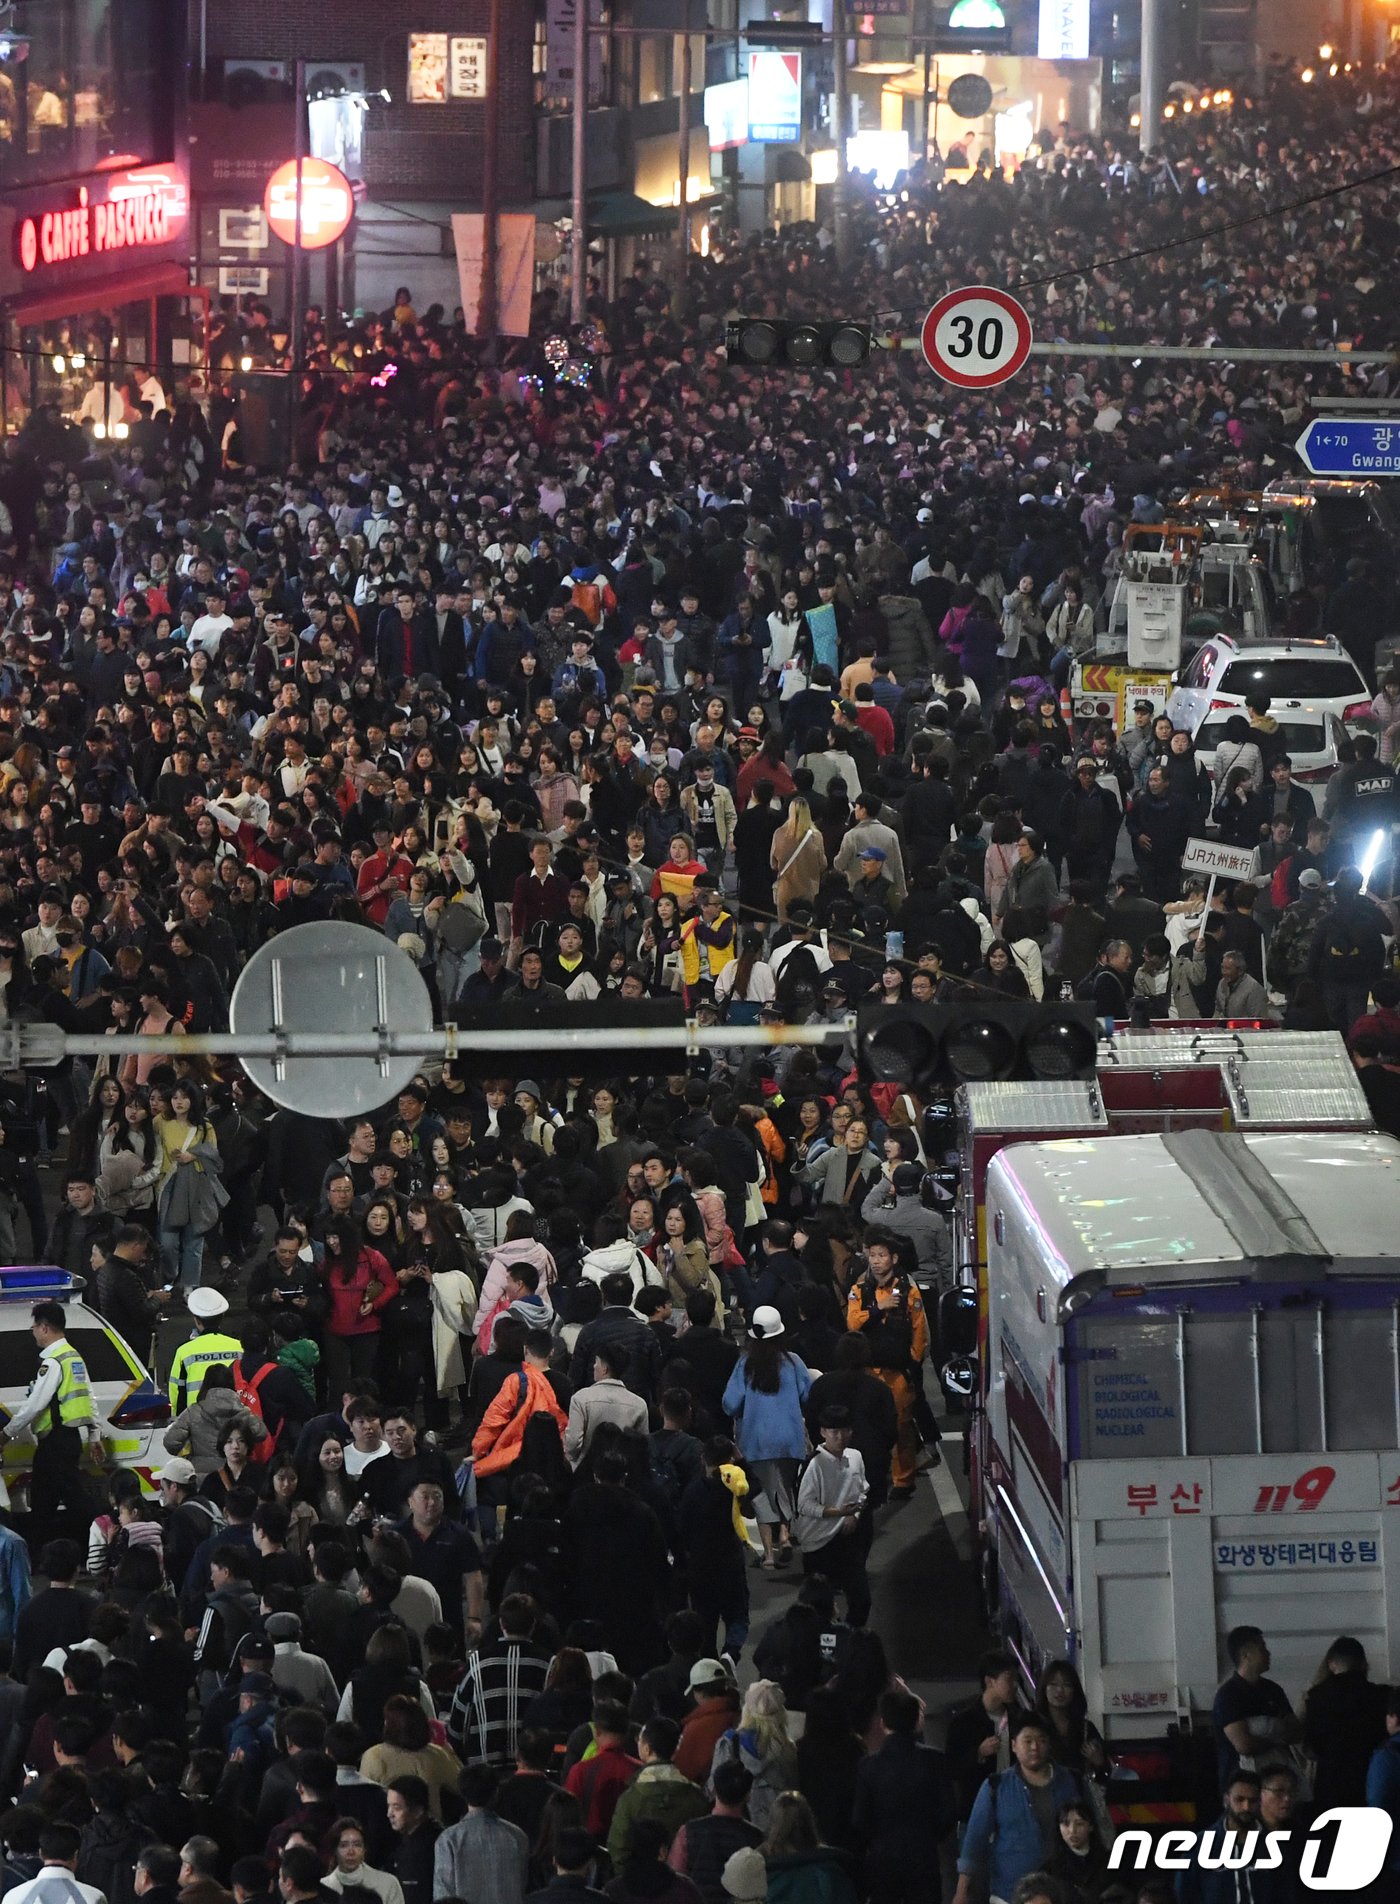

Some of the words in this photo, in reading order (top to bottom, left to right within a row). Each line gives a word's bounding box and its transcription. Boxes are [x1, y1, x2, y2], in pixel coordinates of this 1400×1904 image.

[95, 192, 168, 252] PASCUCCI
[948, 315, 1004, 360] 30
[1372, 427, 1400, 452] 광
[1187, 848, 1251, 872] JR九州旅行
[194, 1351, 239, 1362] POLICE
[1094, 1390, 1161, 1402] BIOLOGICAL
[1095, 1407, 1176, 1419] RADIOLOGICAL
[1095, 1423, 1145, 1436] NUCLEAR
[1127, 1483, 1204, 1516] 부산
[1254, 1465, 1337, 1513] 119
[1217, 1541, 1377, 1567] 화생방테러대응팀
